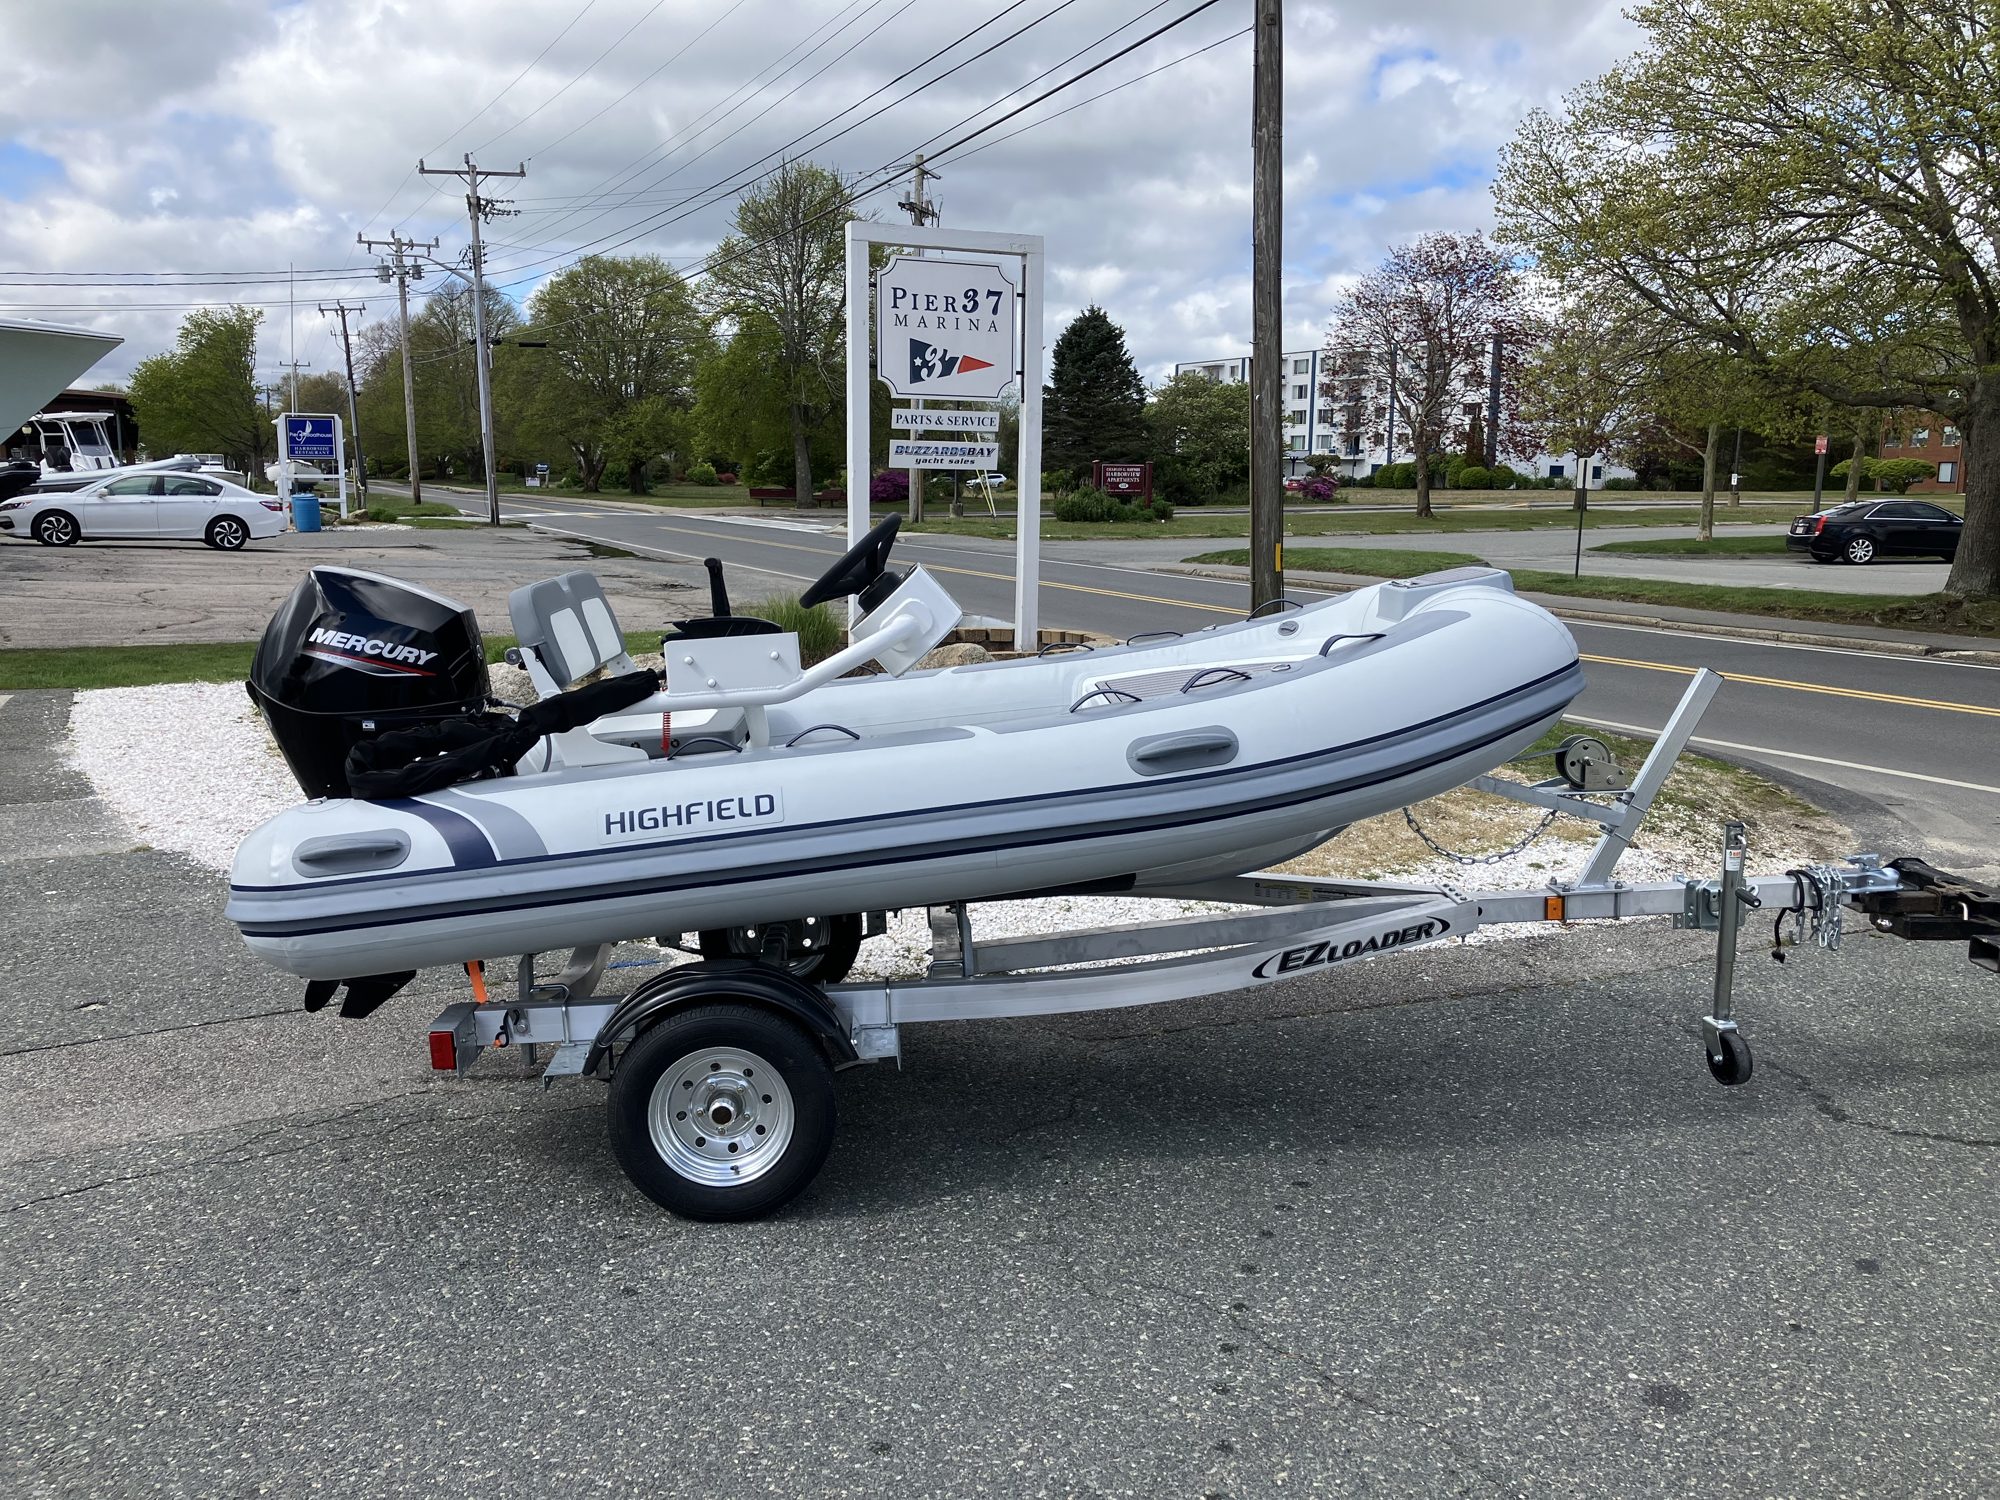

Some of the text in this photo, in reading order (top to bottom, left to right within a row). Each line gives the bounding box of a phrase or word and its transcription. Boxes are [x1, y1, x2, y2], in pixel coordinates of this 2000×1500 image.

[894, 313, 998, 332] MARINA
[895, 414, 997, 427] PARTS & SERVICE
[308, 627, 438, 666] MERCURY
[605, 794, 775, 835] HIGHFIELD
